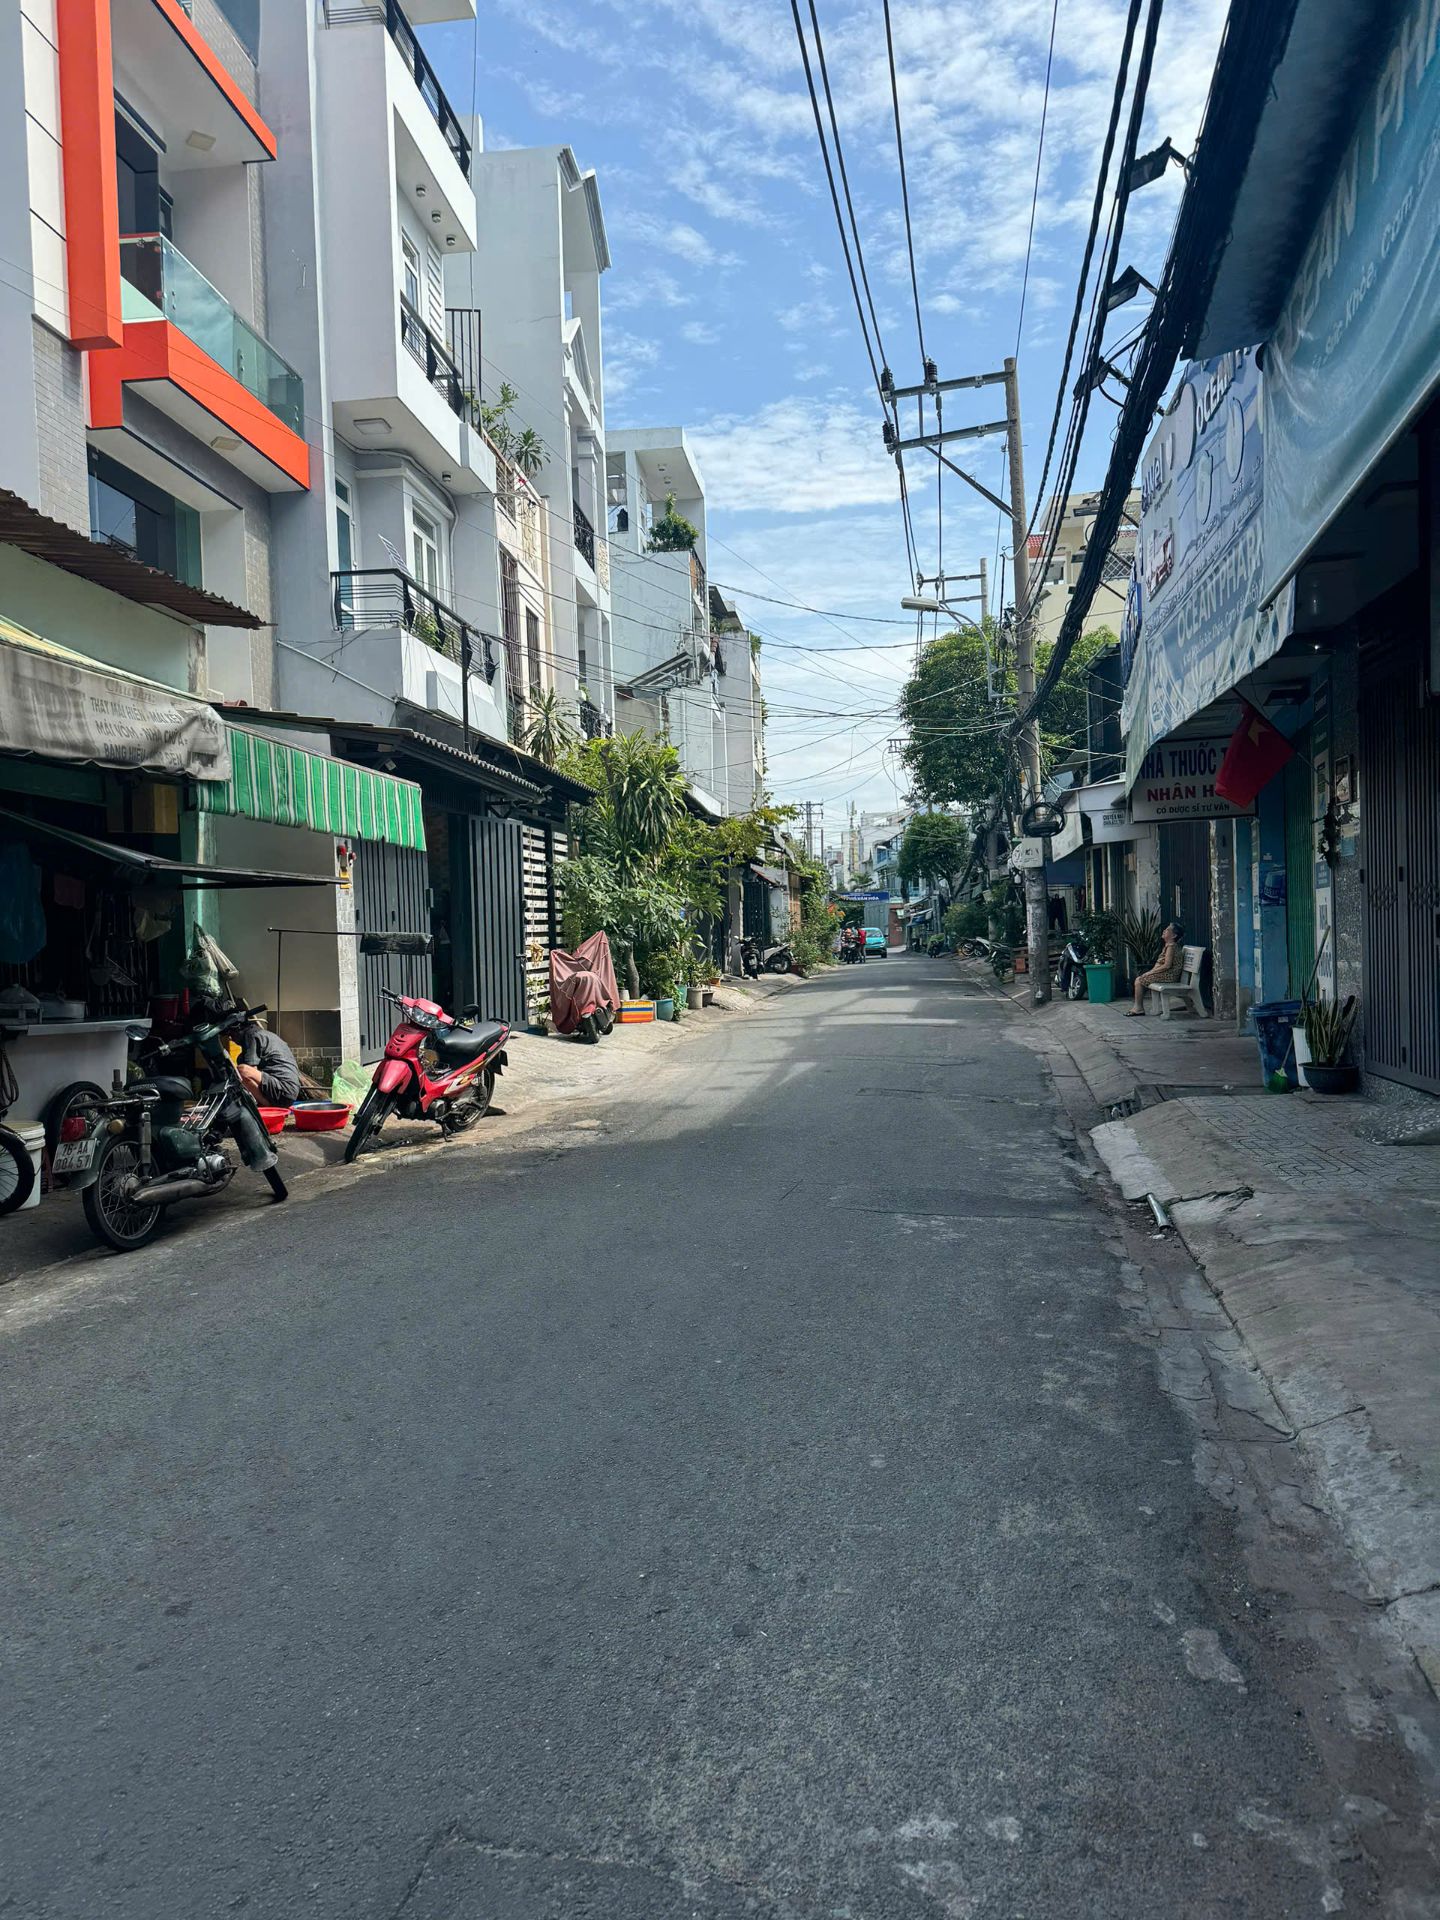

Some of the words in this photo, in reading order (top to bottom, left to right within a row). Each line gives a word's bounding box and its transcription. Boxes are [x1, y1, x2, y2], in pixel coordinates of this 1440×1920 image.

[1178, 576, 1217, 649] OCEAN
[90, 697, 110, 714] THAY
[95, 718, 116, 736] MÁI
[1168, 742, 1216, 777] THUỐC
[1147, 783, 1196, 802] NHÂN
